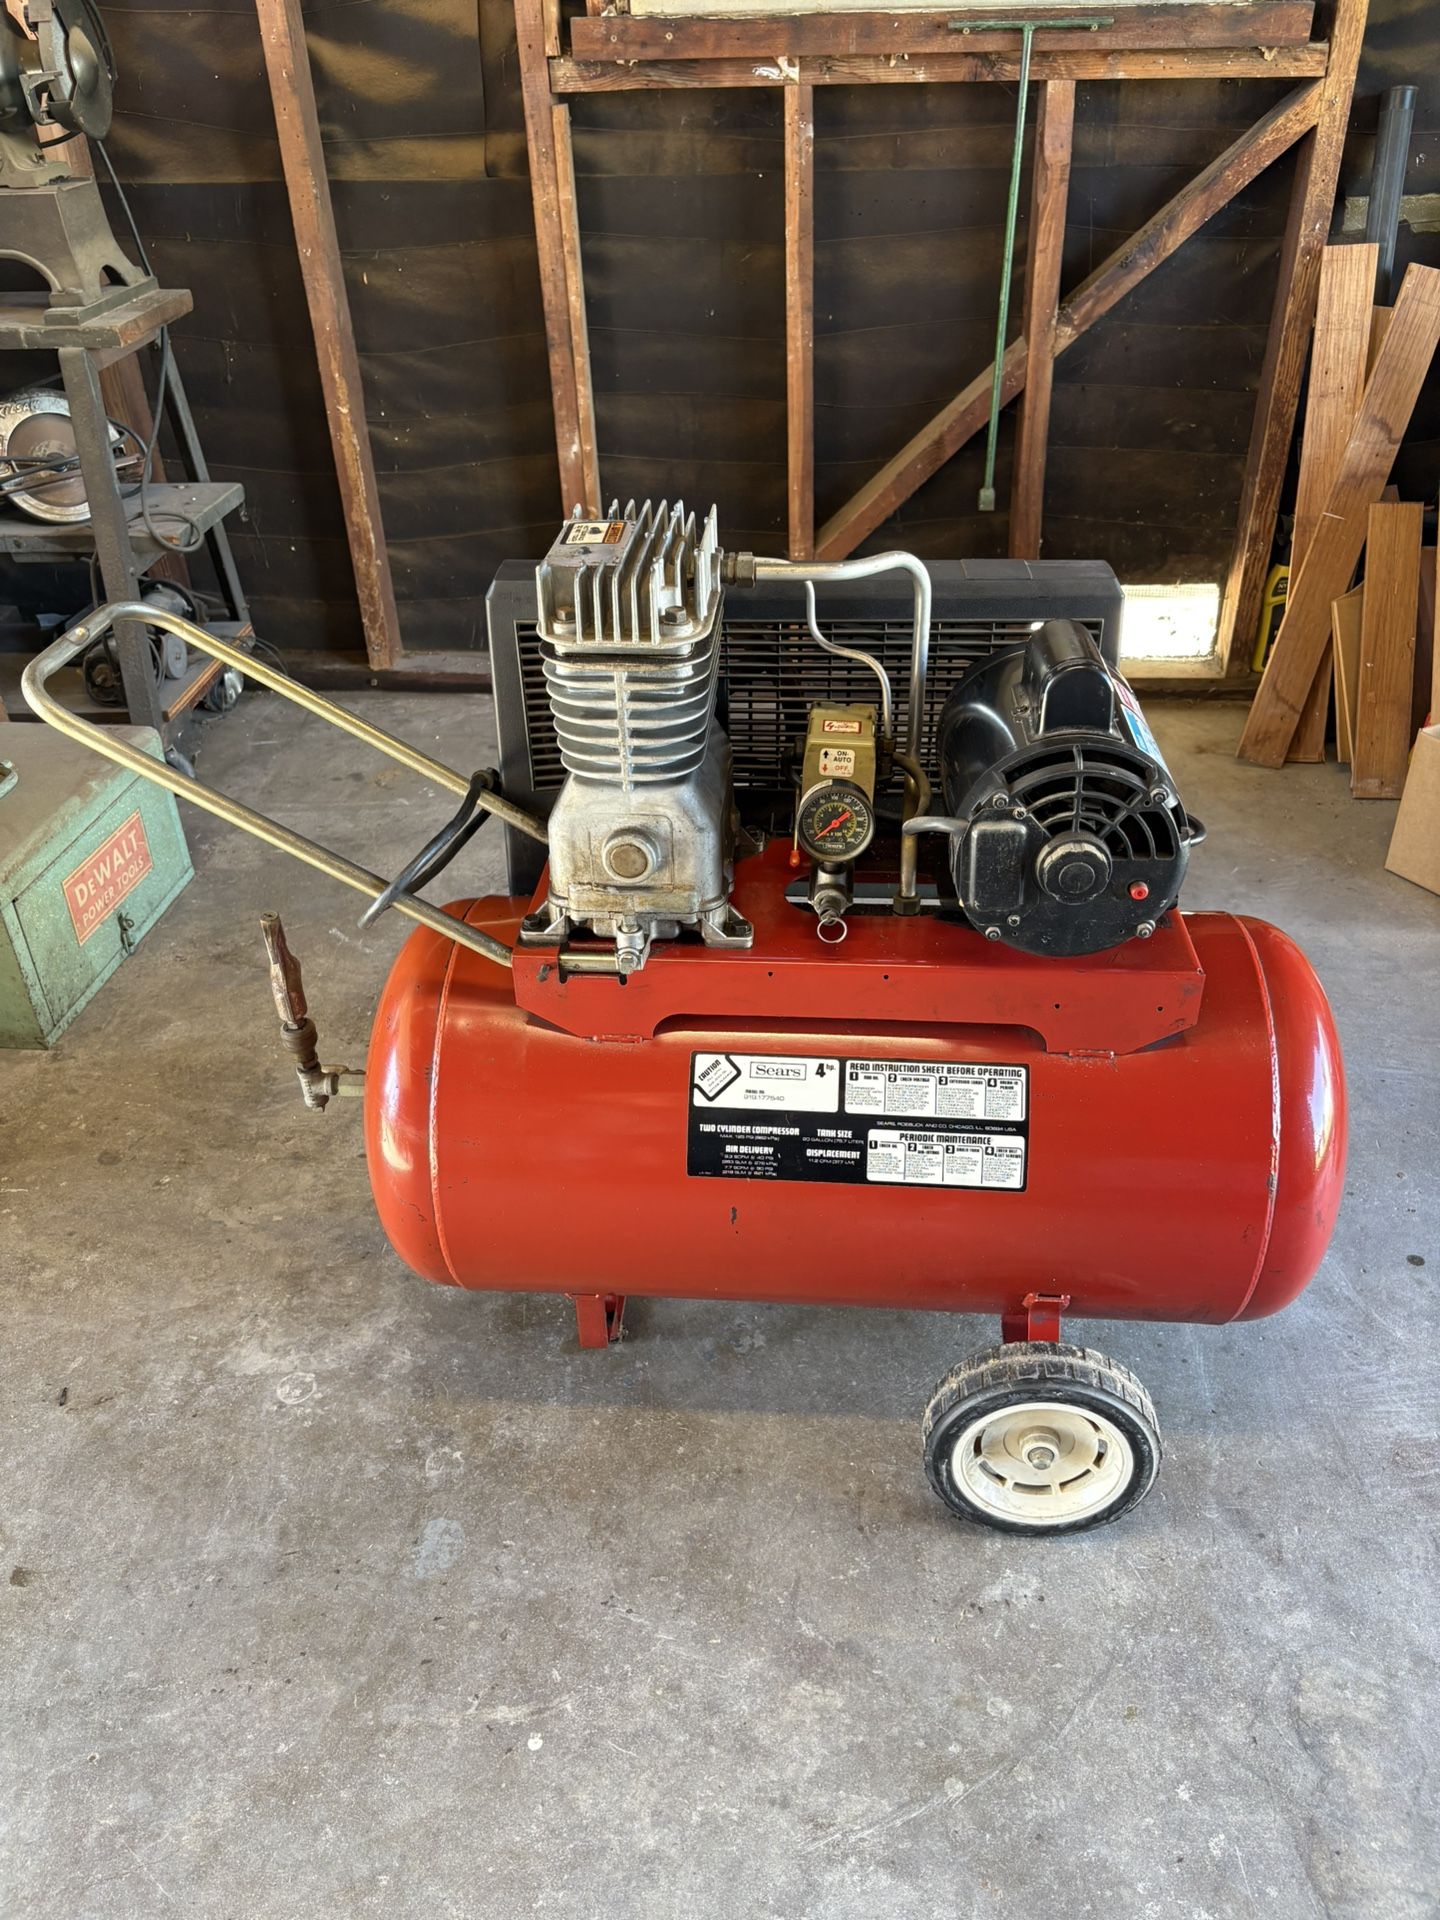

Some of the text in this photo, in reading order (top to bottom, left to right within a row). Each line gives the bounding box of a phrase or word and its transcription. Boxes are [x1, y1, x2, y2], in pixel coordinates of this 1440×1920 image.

[82, 855, 144, 927] POWER TOOLS
[698, 1059, 722, 1082] CAUTION
[755, 1065, 801, 1077] Sears
[815, 1063, 826, 1078] 4
[850, 1062, 1022, 1077] READ INSTRUCTION SHEET BEFORE OPERATING
[699, 1124, 800, 1136] TWO CYLINDER COMPRESSOR
[817, 1128, 852, 1138] TANK SIZE
[899, 1133, 992, 1145] PERIODIC MAINTENANCE
[739, 1145, 774, 1154] DELIVERY
[806, 1148, 860, 1159] DISPLACEMENT
